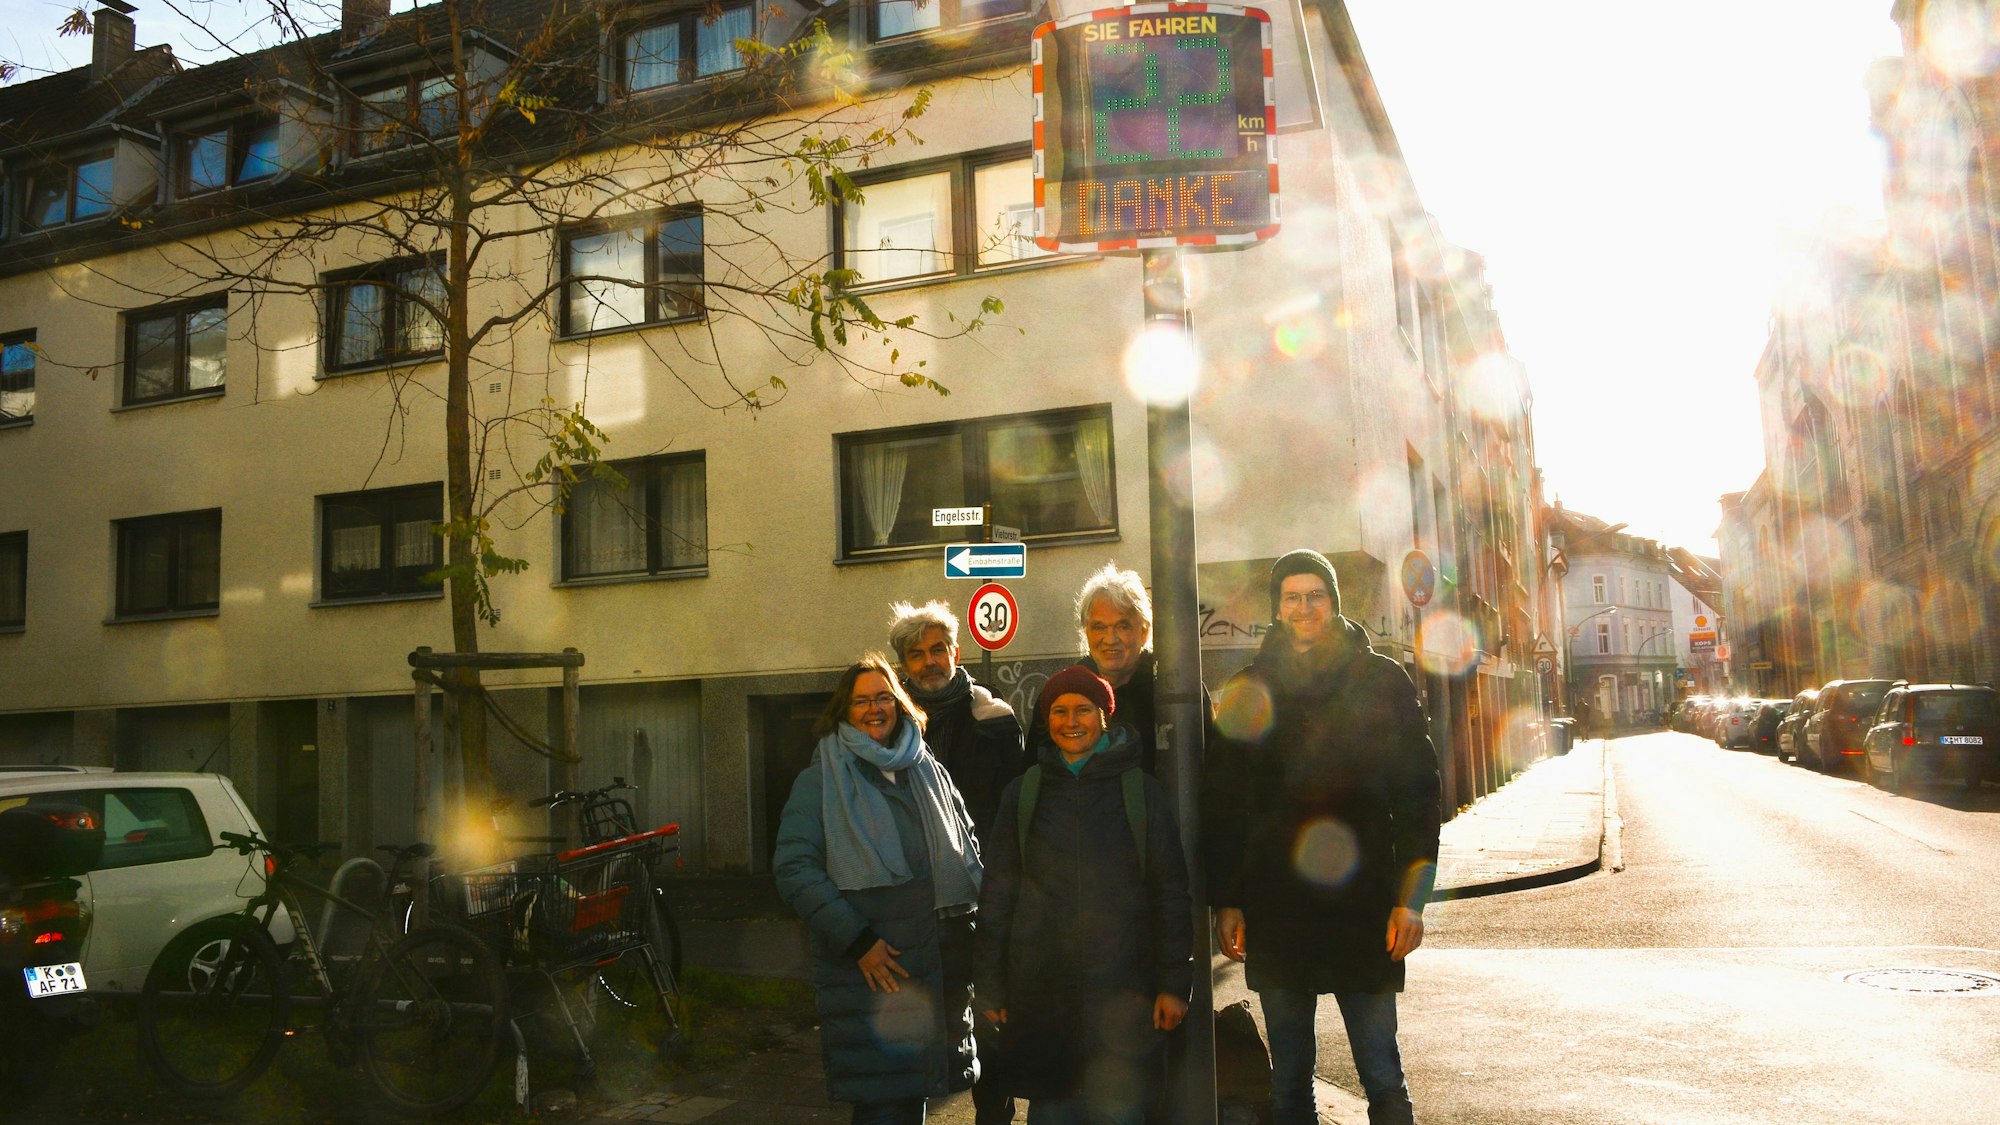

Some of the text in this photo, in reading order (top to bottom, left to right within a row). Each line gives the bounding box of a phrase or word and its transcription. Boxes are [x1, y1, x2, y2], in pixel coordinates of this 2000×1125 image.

[1084, 16, 1217, 42] SIE FAHREN
[1095, 37, 1231, 164] 22
[1238, 114, 1265, 129] km
[1247, 138, 1258, 152] h
[1078, 174, 1234, 236] DANKE
[935, 509, 981, 525] Engelsstr.
[968, 557, 1021, 566] Einbahnstraße
[979, 602, 1007, 632] 30
[1539, 660, 1551, 671] 30
[43, 967, 54, 979] K
[40, 977, 79, 993] AF 71
